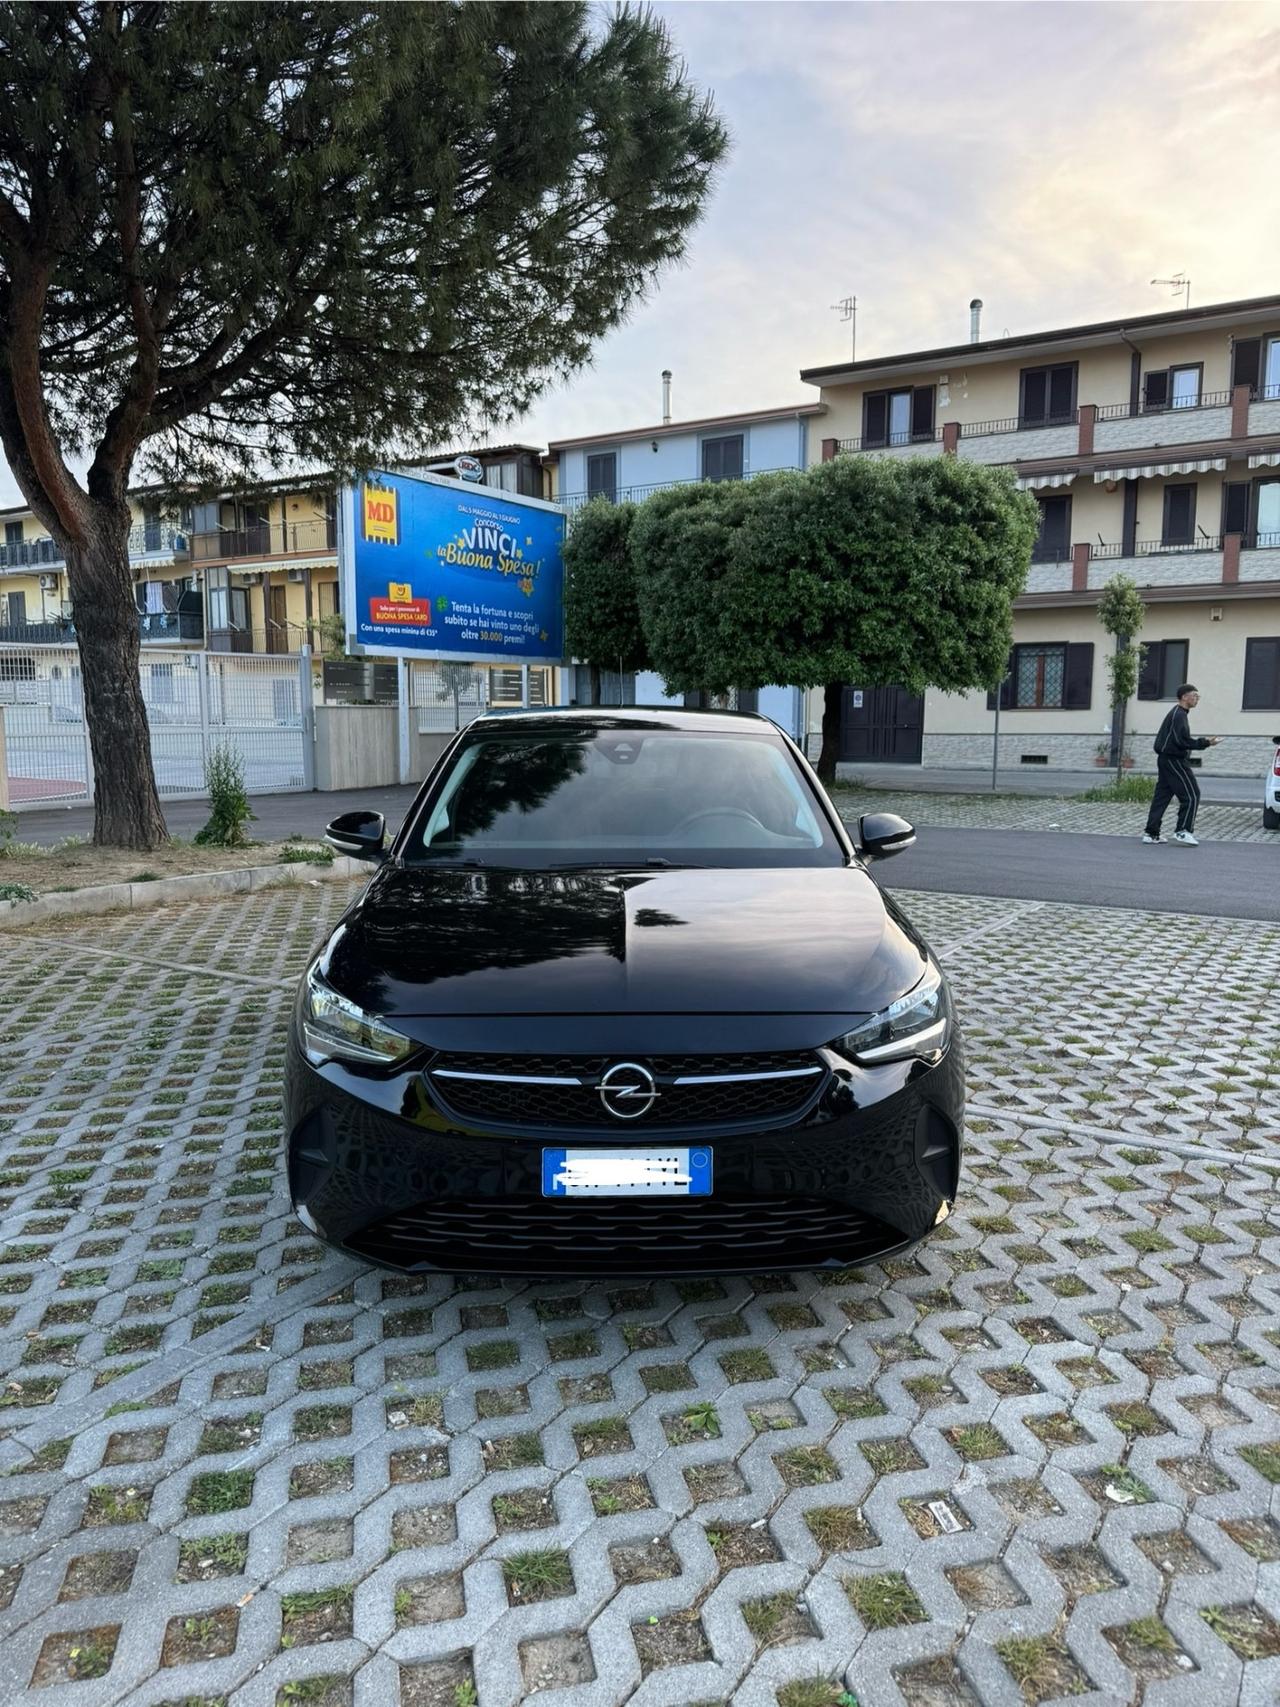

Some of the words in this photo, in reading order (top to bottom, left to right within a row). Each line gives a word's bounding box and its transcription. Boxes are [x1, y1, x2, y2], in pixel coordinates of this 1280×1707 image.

[368, 500, 394, 523] MD
[462, 527, 517, 558] VINCI
[437, 545, 446, 557] la
[446, 542, 493, 569] Buona
[451, 601, 472, 613] Tenta
[473, 603, 480, 614] la
[481, 604, 507, 617] fortuna
[508, 610, 513, 618] e
[513, 611, 534, 622] scopri
[361, 623, 373, 632] Con
[385, 626, 400, 635] spesa
[420, 627, 426, 636] di
[444, 614, 468, 626] subito
[469, 618, 478, 627] se
[478, 617, 490, 629] hai
[490, 619, 509, 630] vinto
[509, 623, 522, 631] uno
[523, 622, 540, 636] degli
[461, 628, 479, 640] oltre
